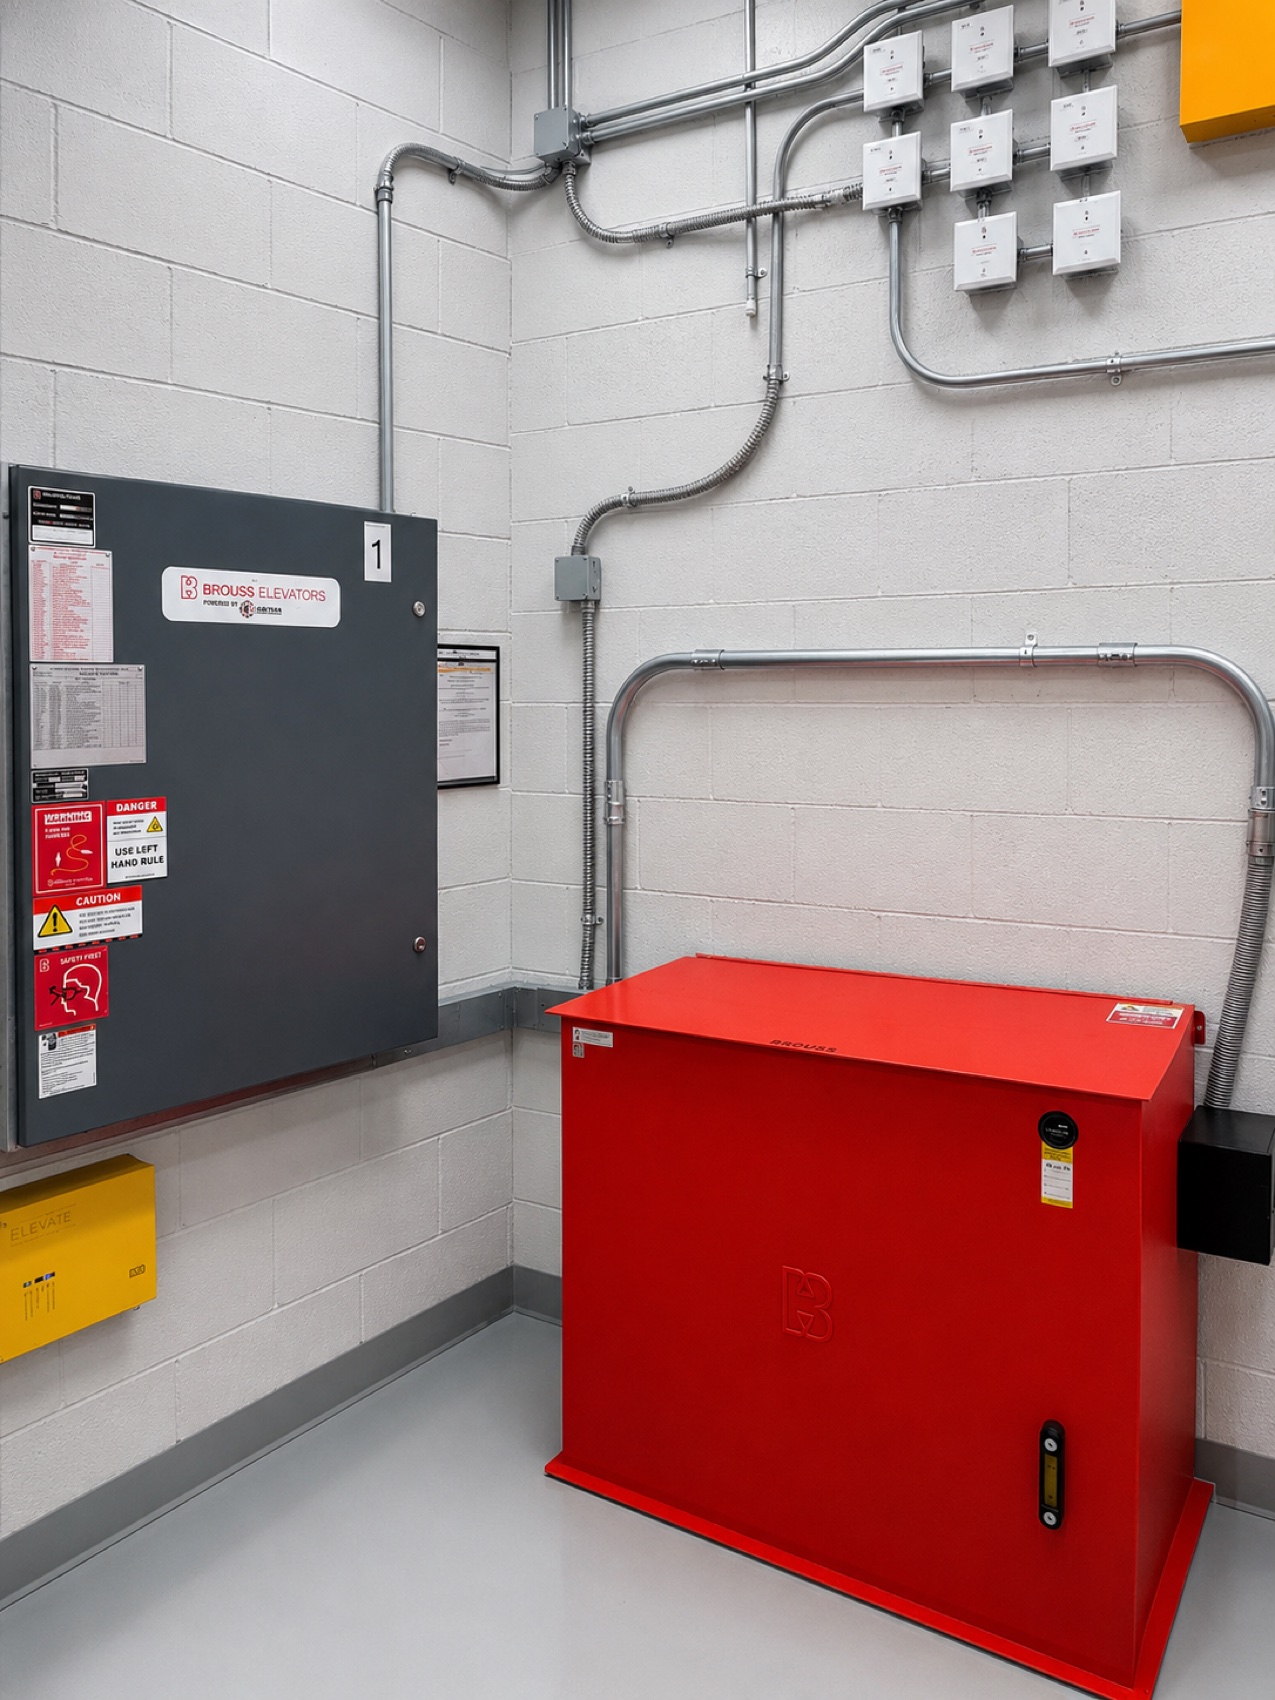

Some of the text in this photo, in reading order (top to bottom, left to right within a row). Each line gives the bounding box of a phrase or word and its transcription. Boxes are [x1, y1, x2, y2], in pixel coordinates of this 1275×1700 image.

[371, 539, 381, 569] 1
[203, 583, 255, 598] BROUSS
[258, 586, 326, 602] ELEVATORS
[116, 801, 157, 812] DANGER
[115, 844, 158, 857] USE LEFT
[111, 855, 164, 869] HAND RULE
[76, 892, 121, 906] CAUTION
[769, 1039, 838, 1053] BROUSS
[10, 1211, 72, 1242] ELEVATE
